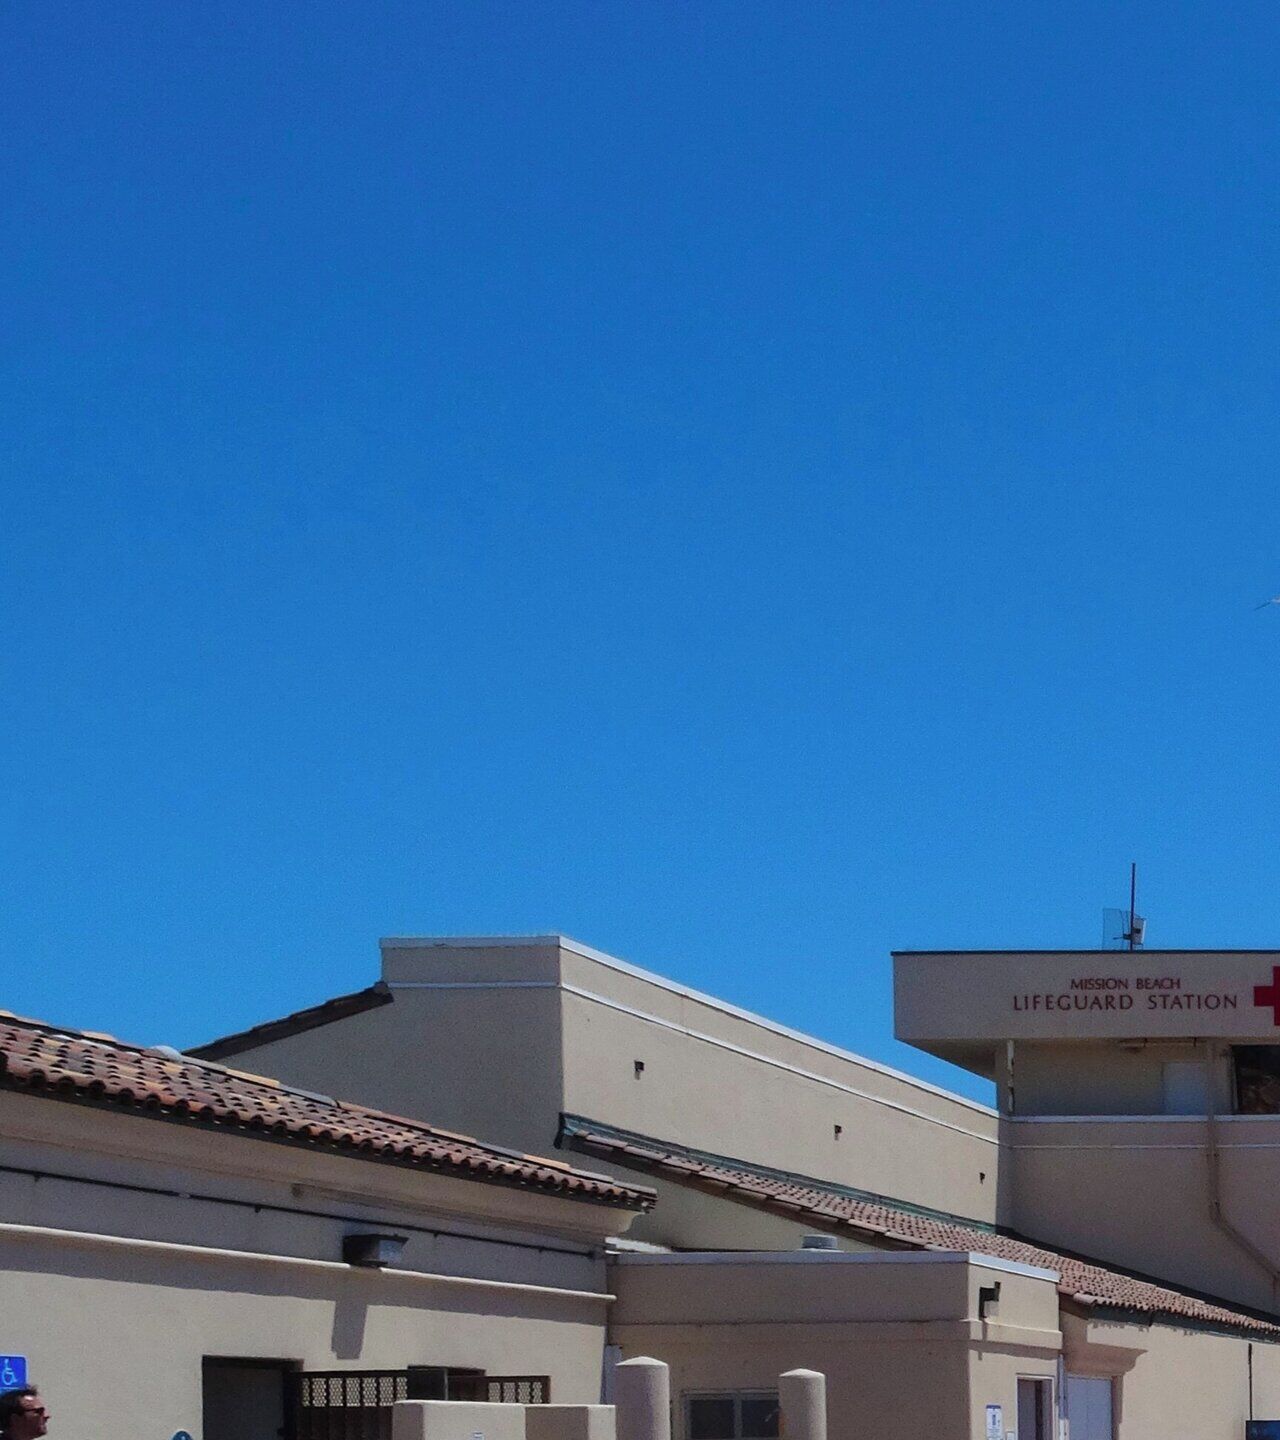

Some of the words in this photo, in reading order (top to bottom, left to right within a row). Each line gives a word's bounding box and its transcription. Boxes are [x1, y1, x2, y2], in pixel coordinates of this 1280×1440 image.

[1070, 978, 1129, 990] MISSION
[1136, 977, 1181, 990] BEACH
[1013, 994, 1134, 1011] LIFEGUARD
[1147, 994, 1238, 1011] STATION
